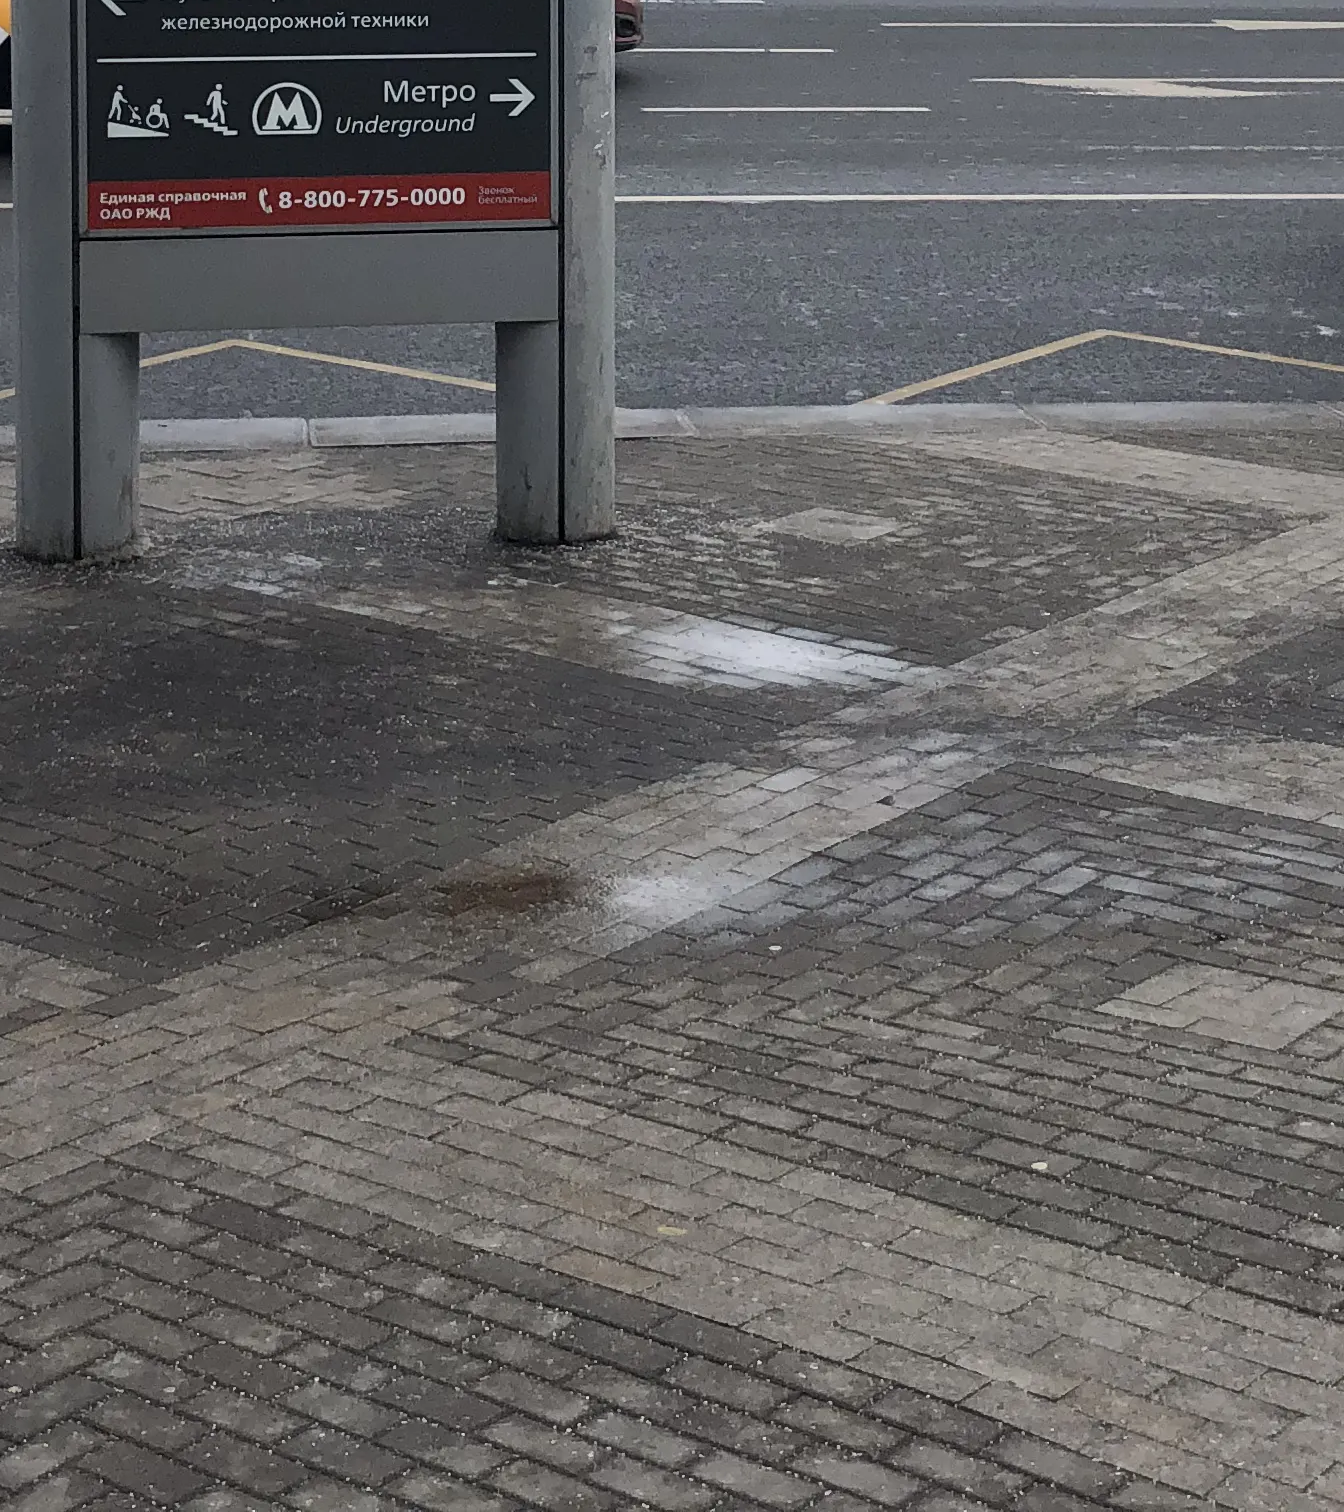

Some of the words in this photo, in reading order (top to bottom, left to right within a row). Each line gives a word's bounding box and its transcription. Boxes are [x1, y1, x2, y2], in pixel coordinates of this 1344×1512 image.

[161, 11, 346, 33] железнодорожной
[351, 14, 429, 29] техники
[384, 80, 476, 108] Метро
[336, 114, 476, 138] Underground
[100, 192, 155, 205] Единая
[158, 191, 247, 205] справочная
[279, 187, 465, 209] 8-800-775-0000
[100, 208, 133, 220] ОАО
[136, 208, 171, 221] РЖД
